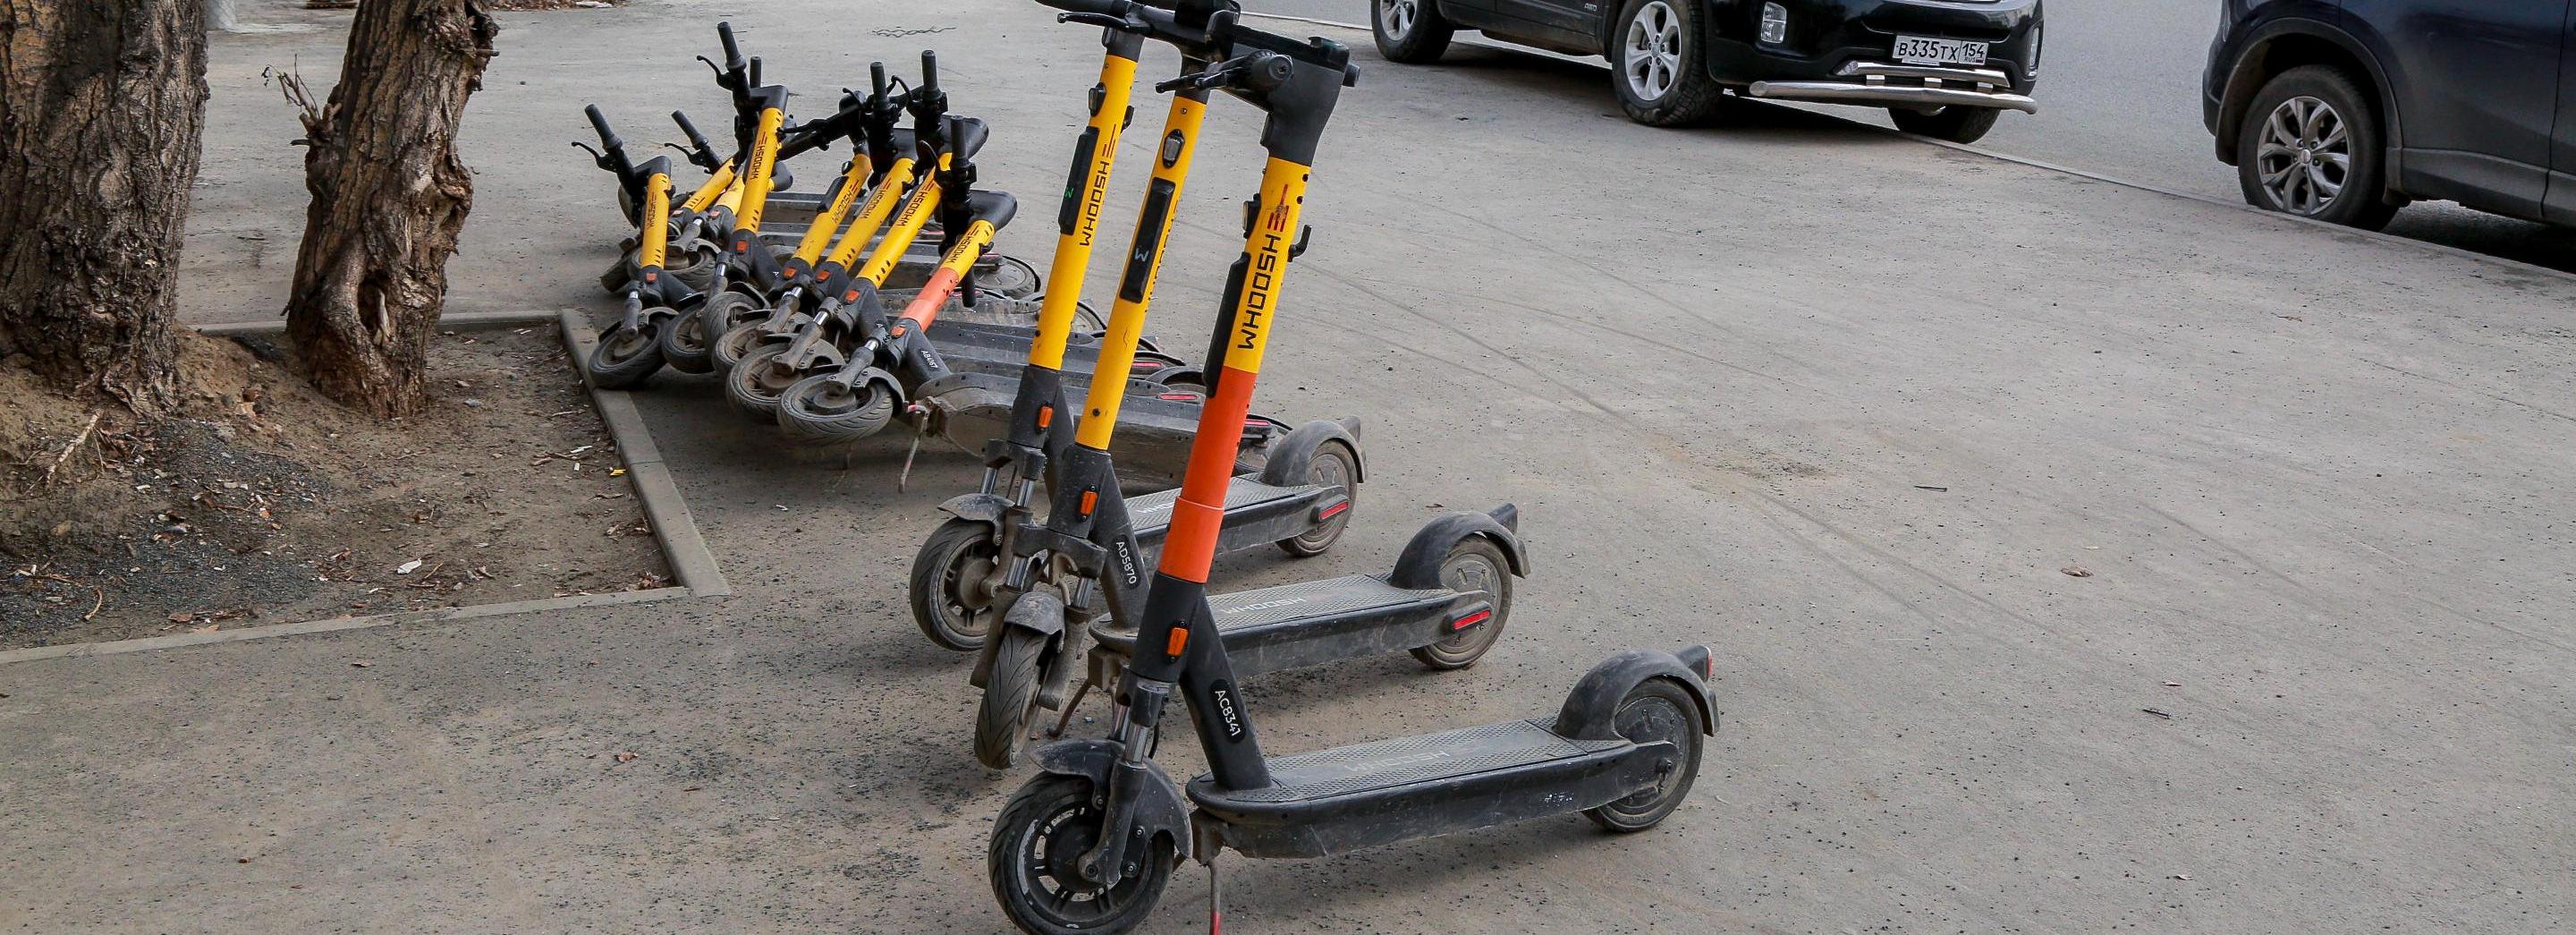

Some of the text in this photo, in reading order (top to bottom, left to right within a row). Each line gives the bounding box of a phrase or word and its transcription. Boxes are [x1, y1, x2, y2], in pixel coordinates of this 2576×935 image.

[1962, 43, 1986, 58] 154
[750, 145, 765, 180] WHOOSH
[897, 191, 928, 226] WHOOSH
[1080, 160, 1110, 246] WHOOSH
[945, 234, 974, 264] WHOOSH
[1237, 234, 1282, 350] WHOOSH
[1115, 541, 1137, 585] AD5870
[1220, 597, 1306, 615] WHOOSH
[1215, 690, 1241, 736] AC8341
